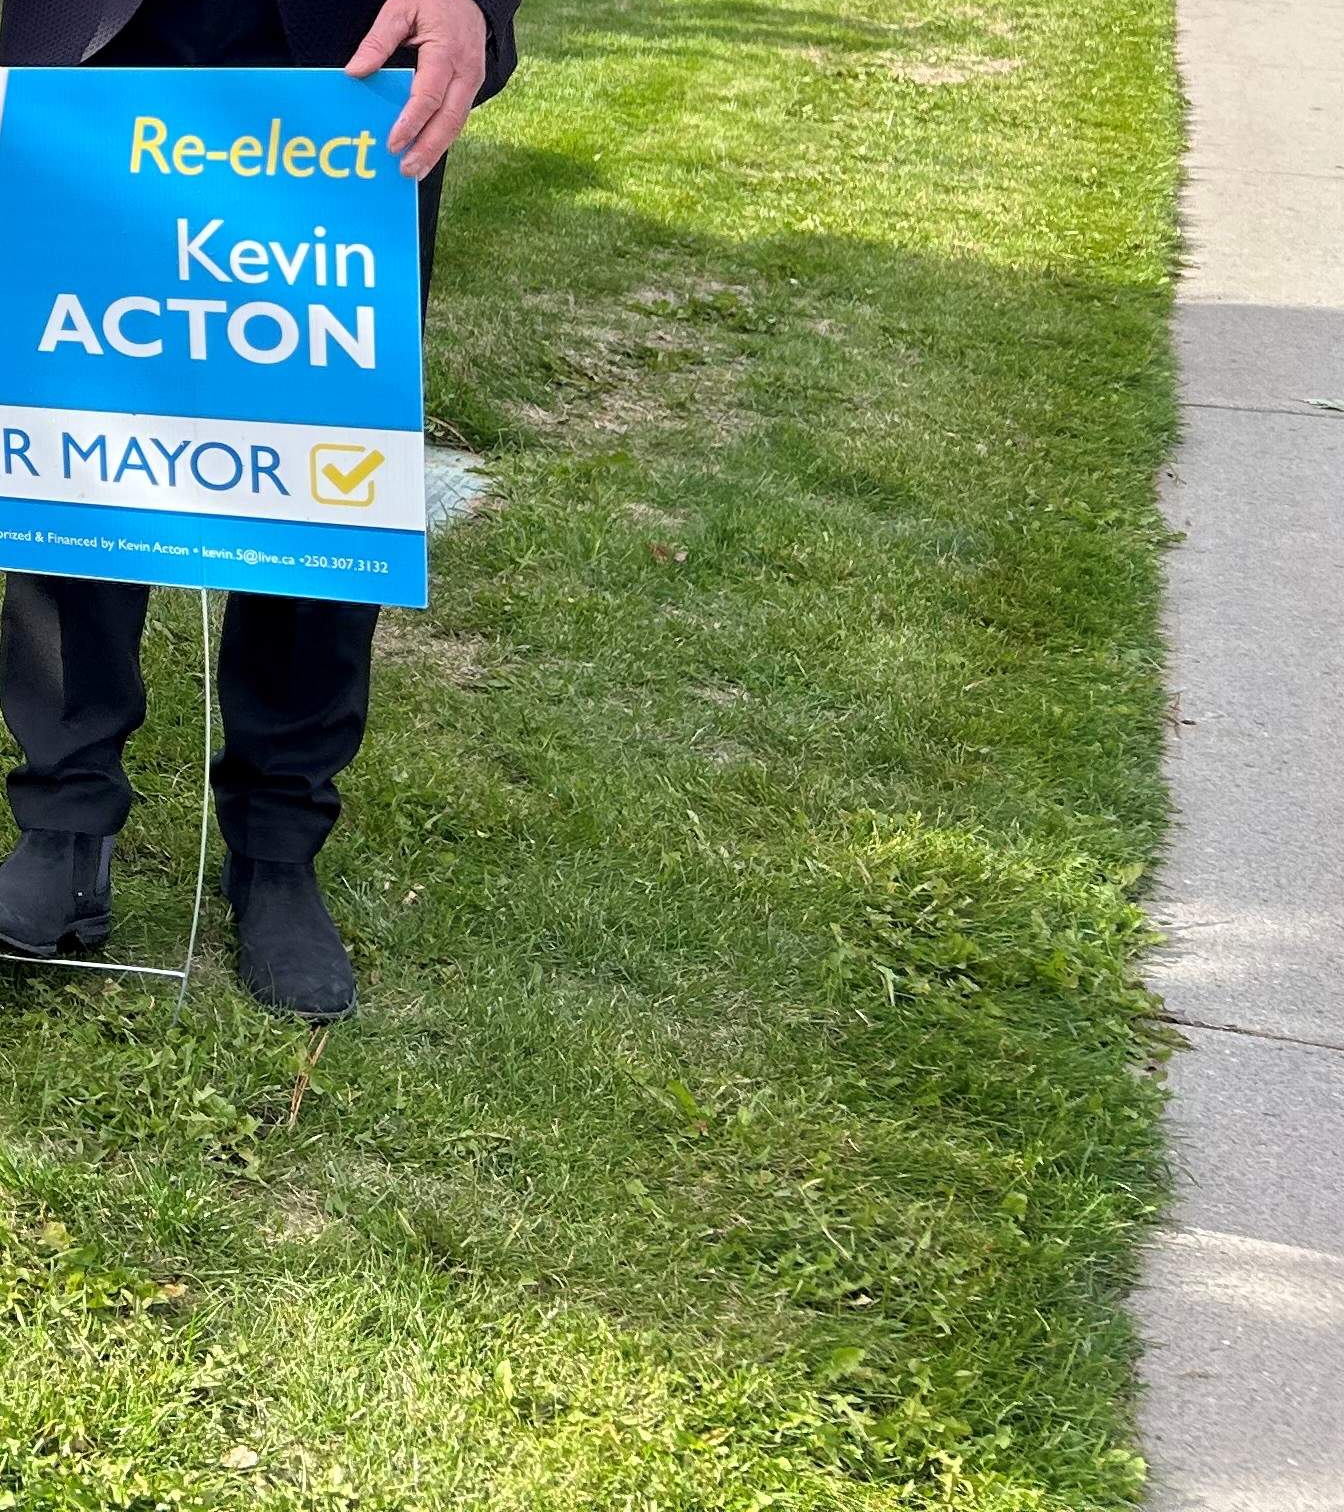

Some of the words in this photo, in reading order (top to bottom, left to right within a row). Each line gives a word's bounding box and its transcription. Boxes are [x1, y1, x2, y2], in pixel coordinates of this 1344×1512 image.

[129, 116, 377, 180] Re-elect
[176, 217, 376, 289] Kevin
[37, 293, 376, 371] ACTON
[61, 431, 291, 497] MAYOR
[34, 531, 45, 543] &
[47, 532, 98, 548] Financed
[100, 538, 115, 552] by
[118, 540, 150, 552] Kevin
[152, 541, 189, 556] Acton
